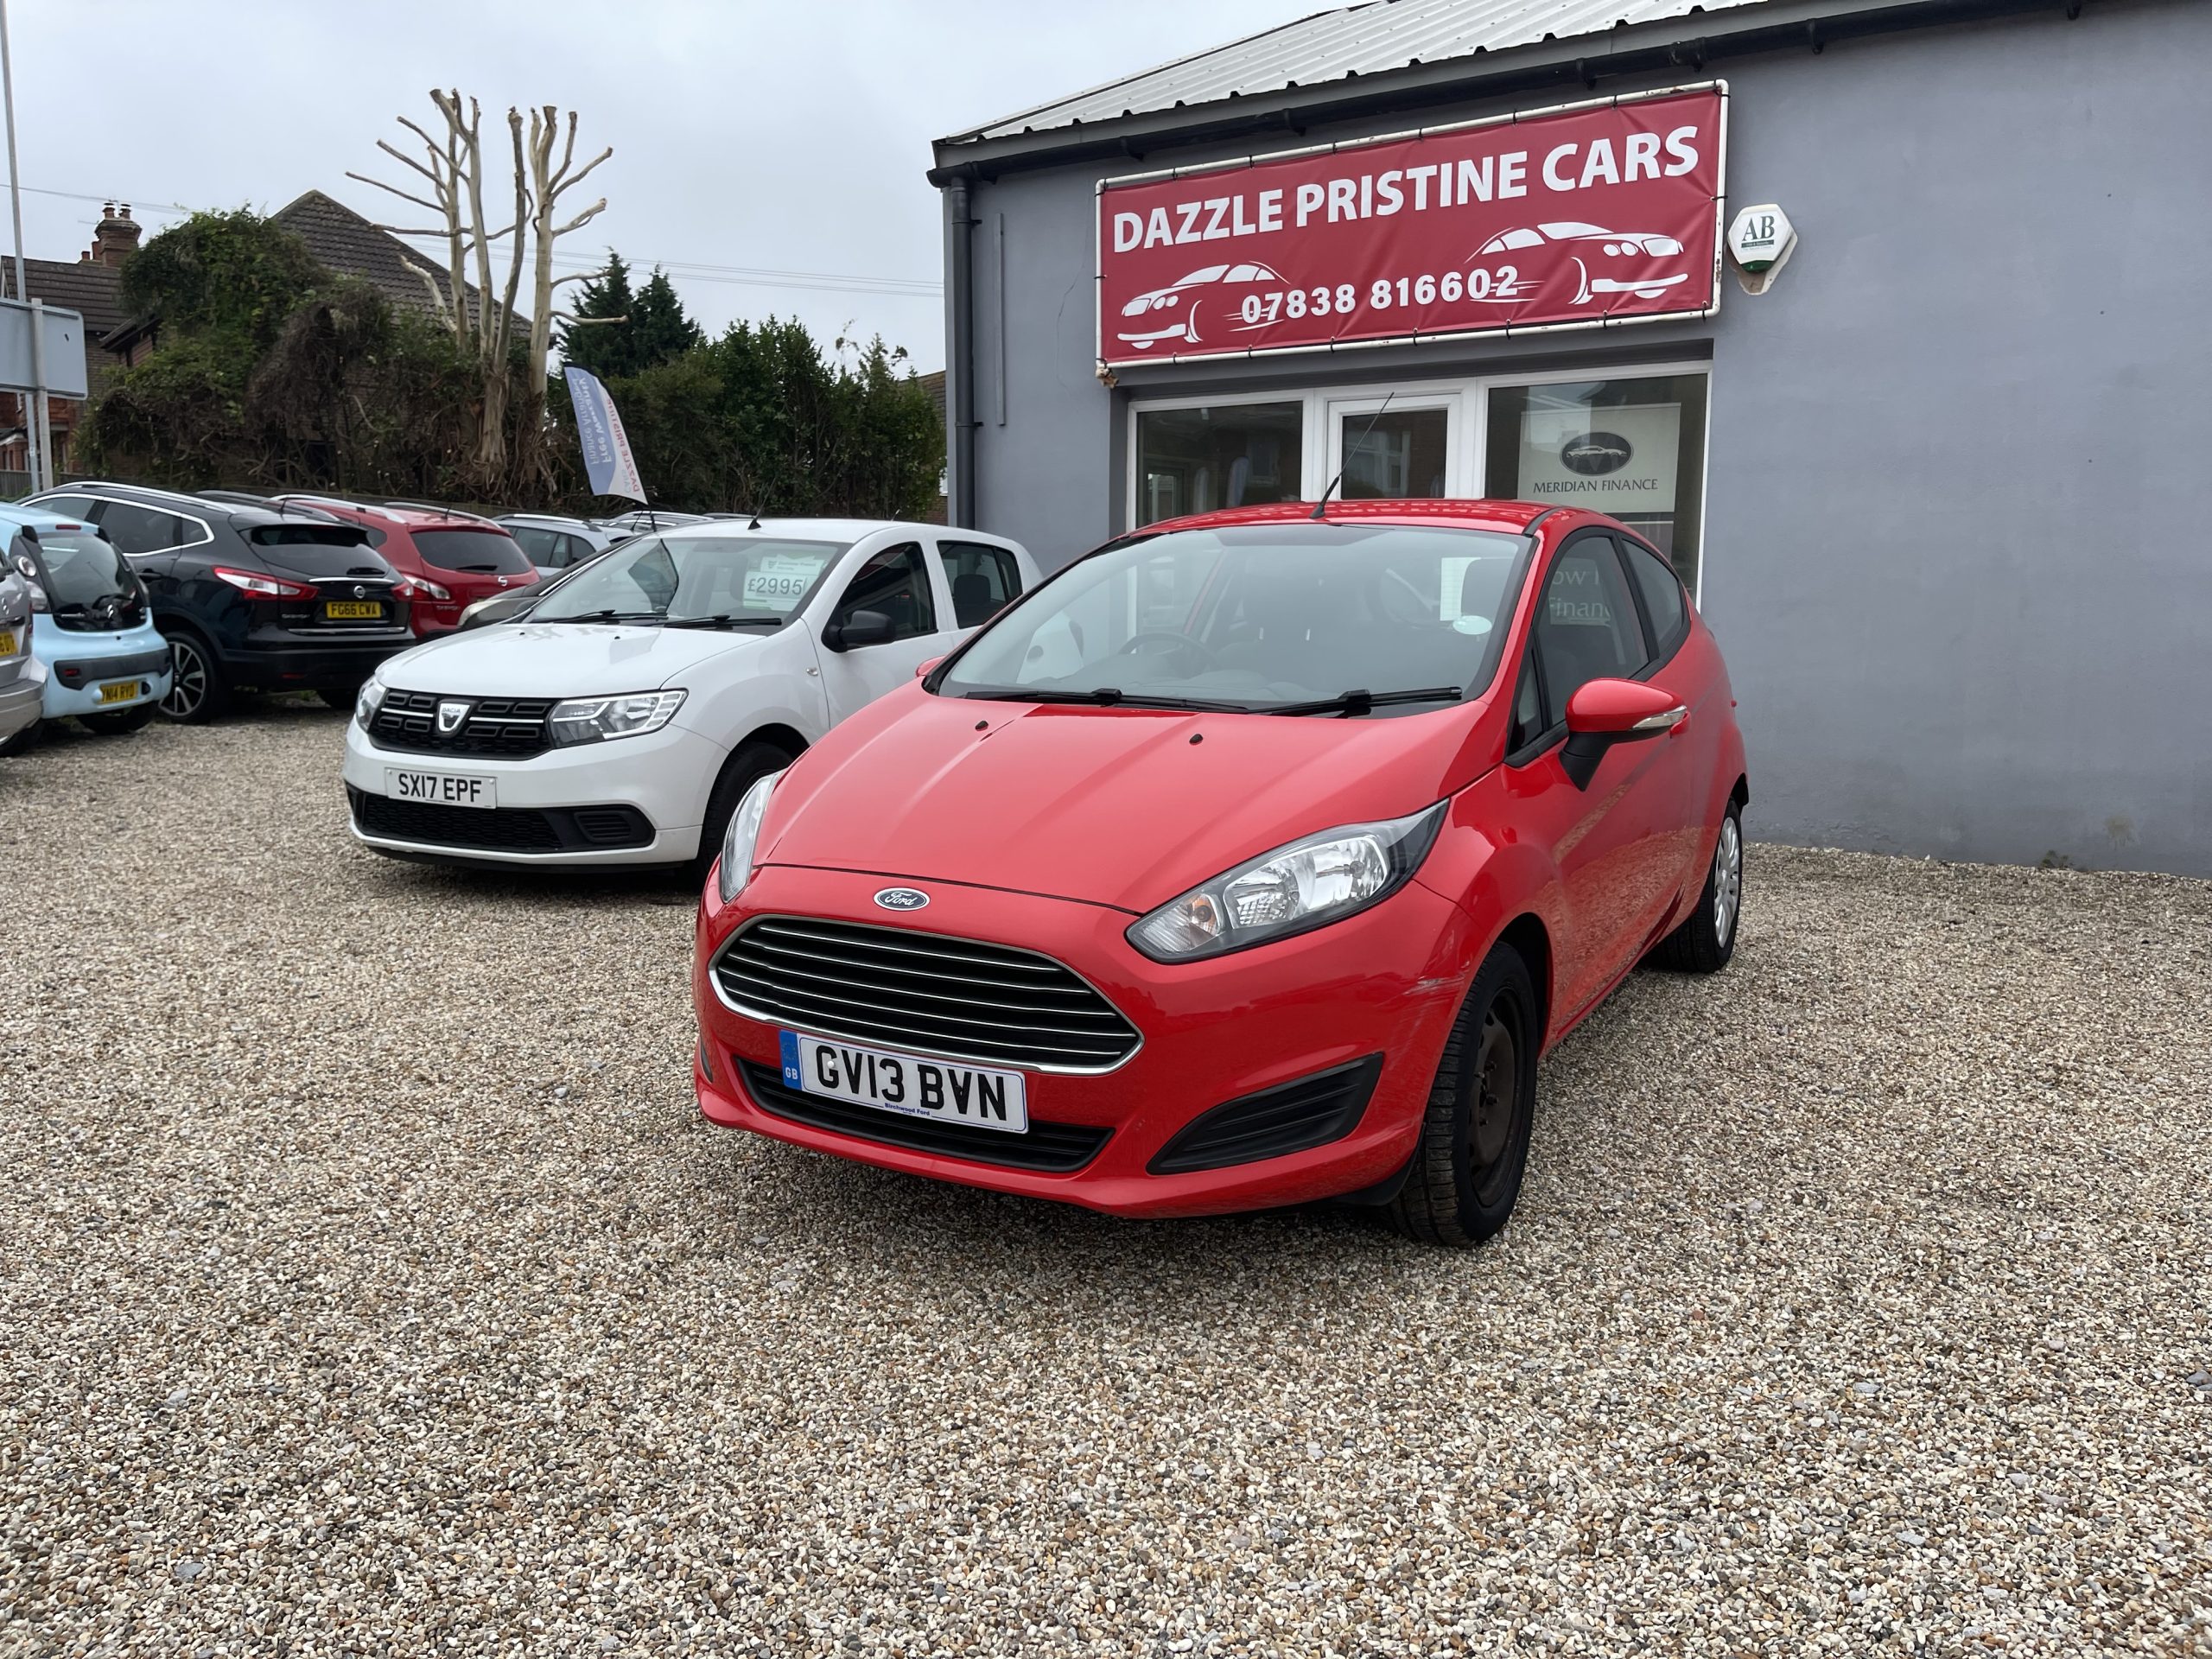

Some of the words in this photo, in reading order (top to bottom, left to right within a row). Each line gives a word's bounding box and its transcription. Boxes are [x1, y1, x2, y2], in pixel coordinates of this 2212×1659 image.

[1114, 188, 1284, 253] DAZZLE
[1296, 150, 1528, 227] PRISTINE
[1541, 125, 1700, 192] CARS
[1741, 215, 1775, 242] AB
[1241, 283, 1357, 324] 07838
[1370, 265, 1518, 309] 816602
[1533, 480, 1598, 493] MERIDIAN
[1602, 479, 1659, 492] FINANCE
[747, 577, 804, 595] £2995
[331, 603, 357, 616] FG66
[359, 603, 377, 616] CWA
[398, 773, 437, 798] SX17
[443, 777, 482, 803] EPF
[885, 892, 918, 906] Ford
[785, 1066, 798, 1080] GB
[816, 1045, 906, 1103] GV13
[917, 1064, 1007, 1122] BVN
[884, 1103, 916, 1114] Birchwood
